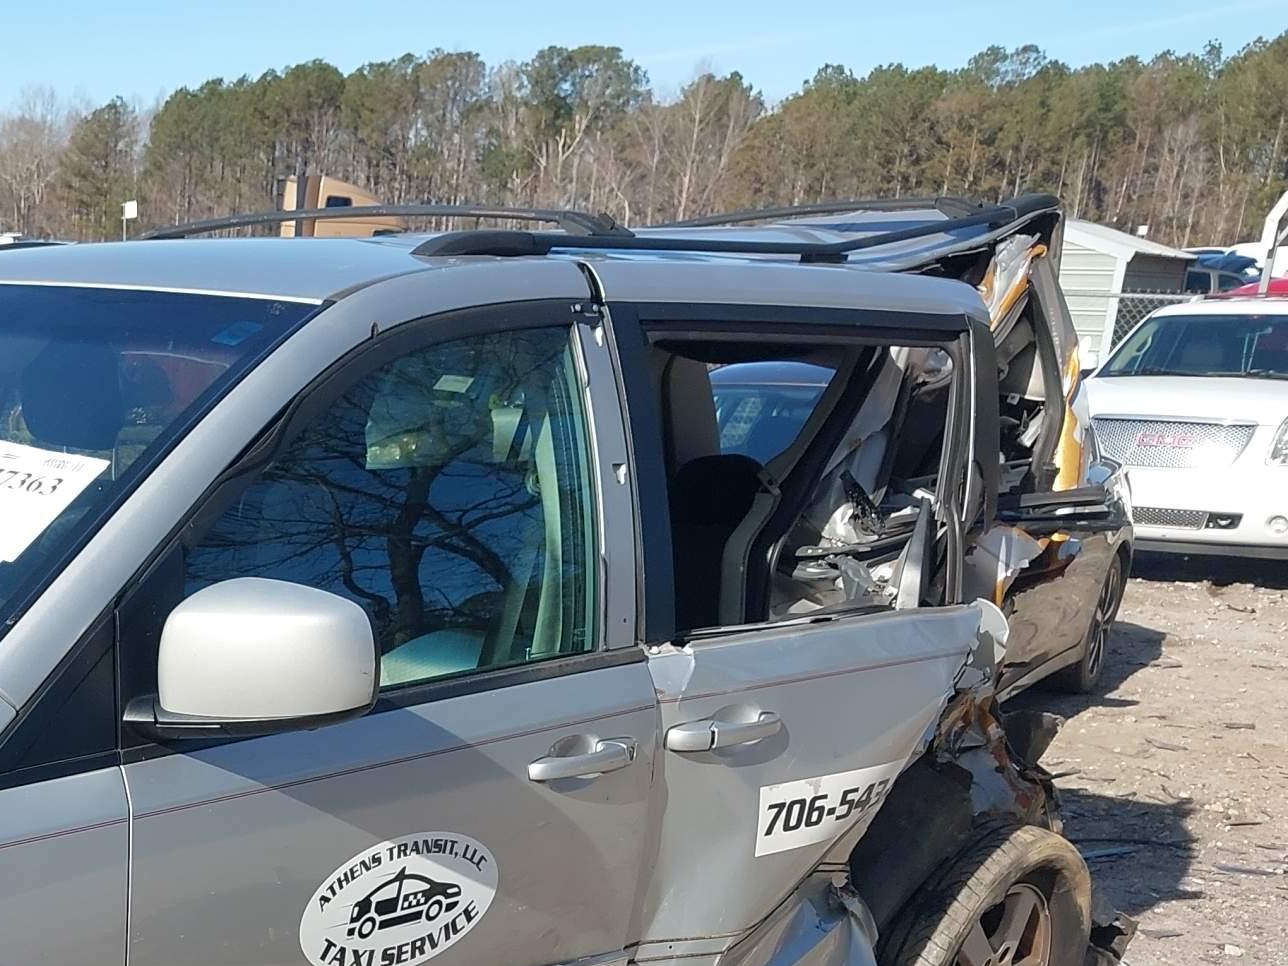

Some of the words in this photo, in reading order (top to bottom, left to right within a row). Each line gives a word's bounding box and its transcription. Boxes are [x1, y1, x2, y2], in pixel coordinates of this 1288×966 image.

[318, 852, 382, 912] ATHENS
[386, 838, 459, 859] TRANSIT,
[462, 844, 488, 873] LLC
